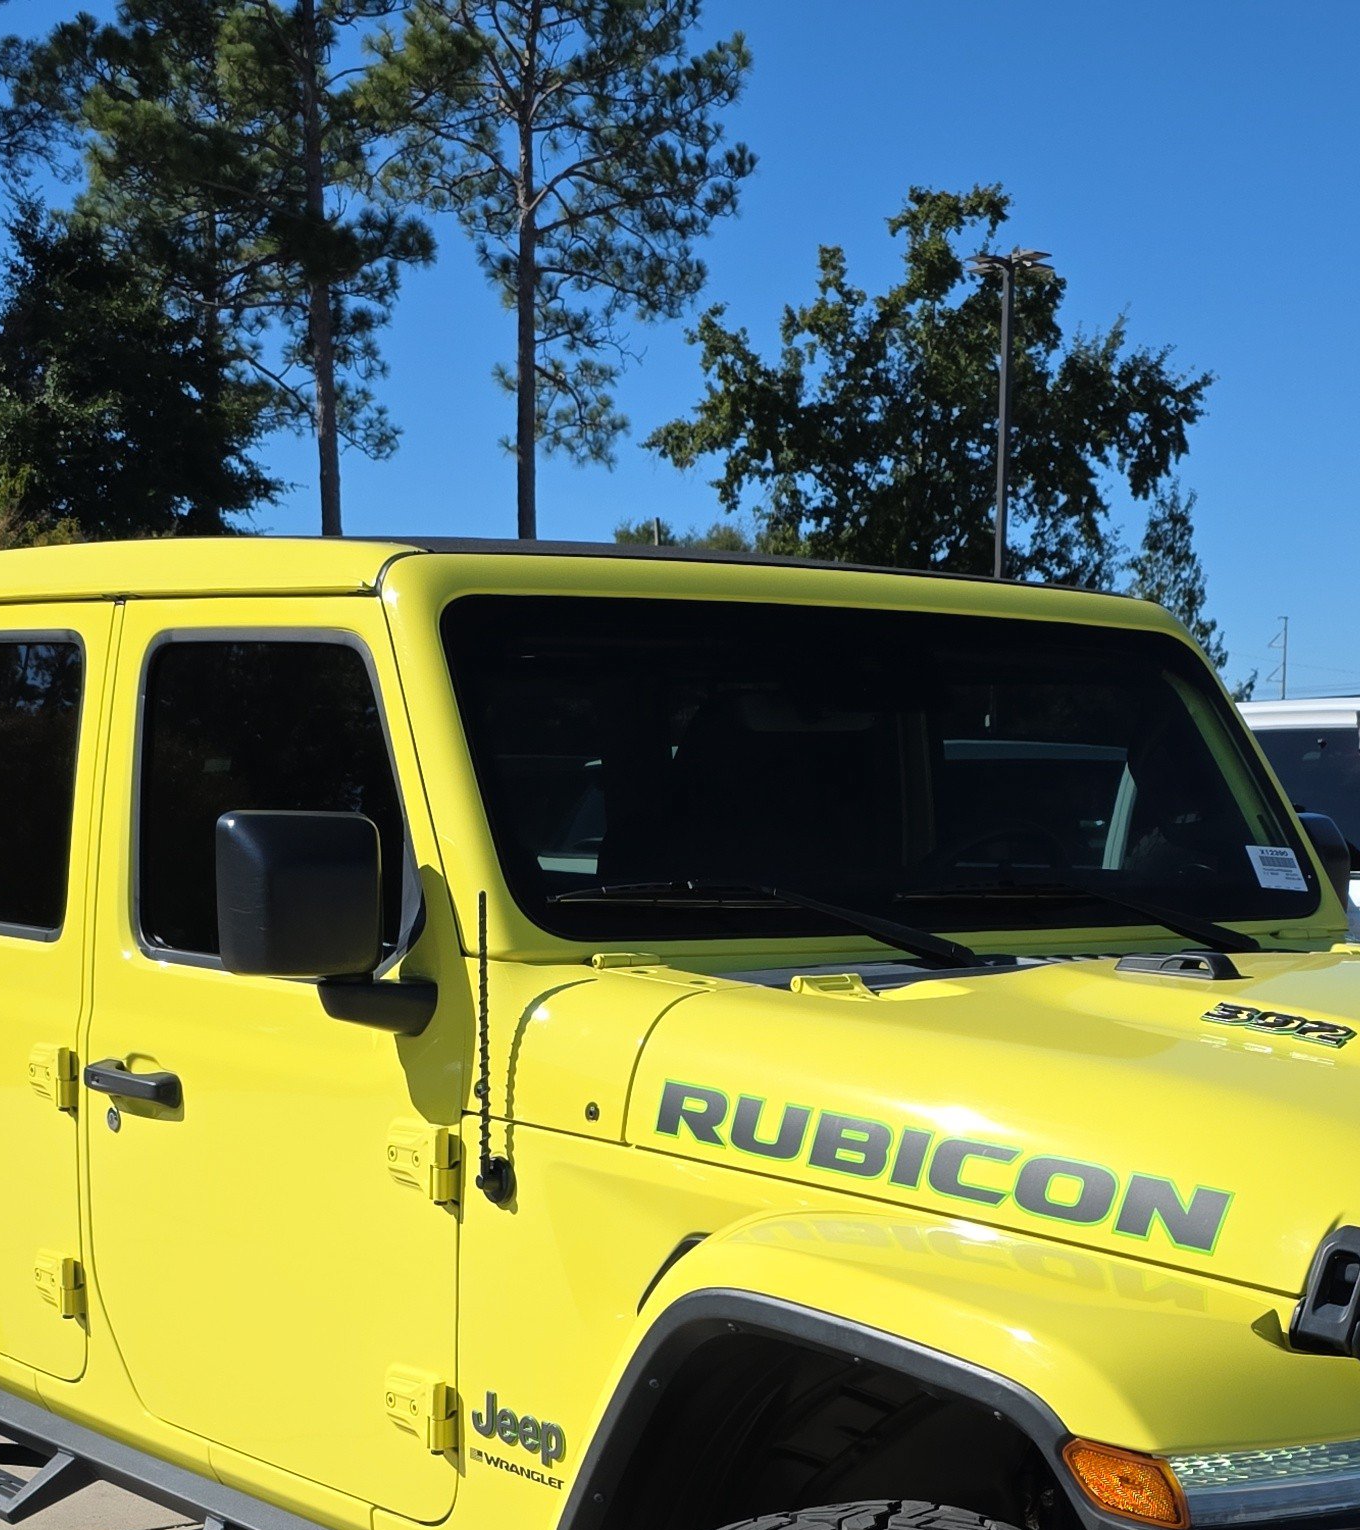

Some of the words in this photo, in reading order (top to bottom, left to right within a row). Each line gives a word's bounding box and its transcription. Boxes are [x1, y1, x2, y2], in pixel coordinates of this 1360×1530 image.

[1200, 1002, 1357, 1049] 392
[654, 1079, 1235, 1255] RUBICON
[471, 1390, 566, 1469] Jeep
[484, 1452, 564, 1490] WRANGLER
